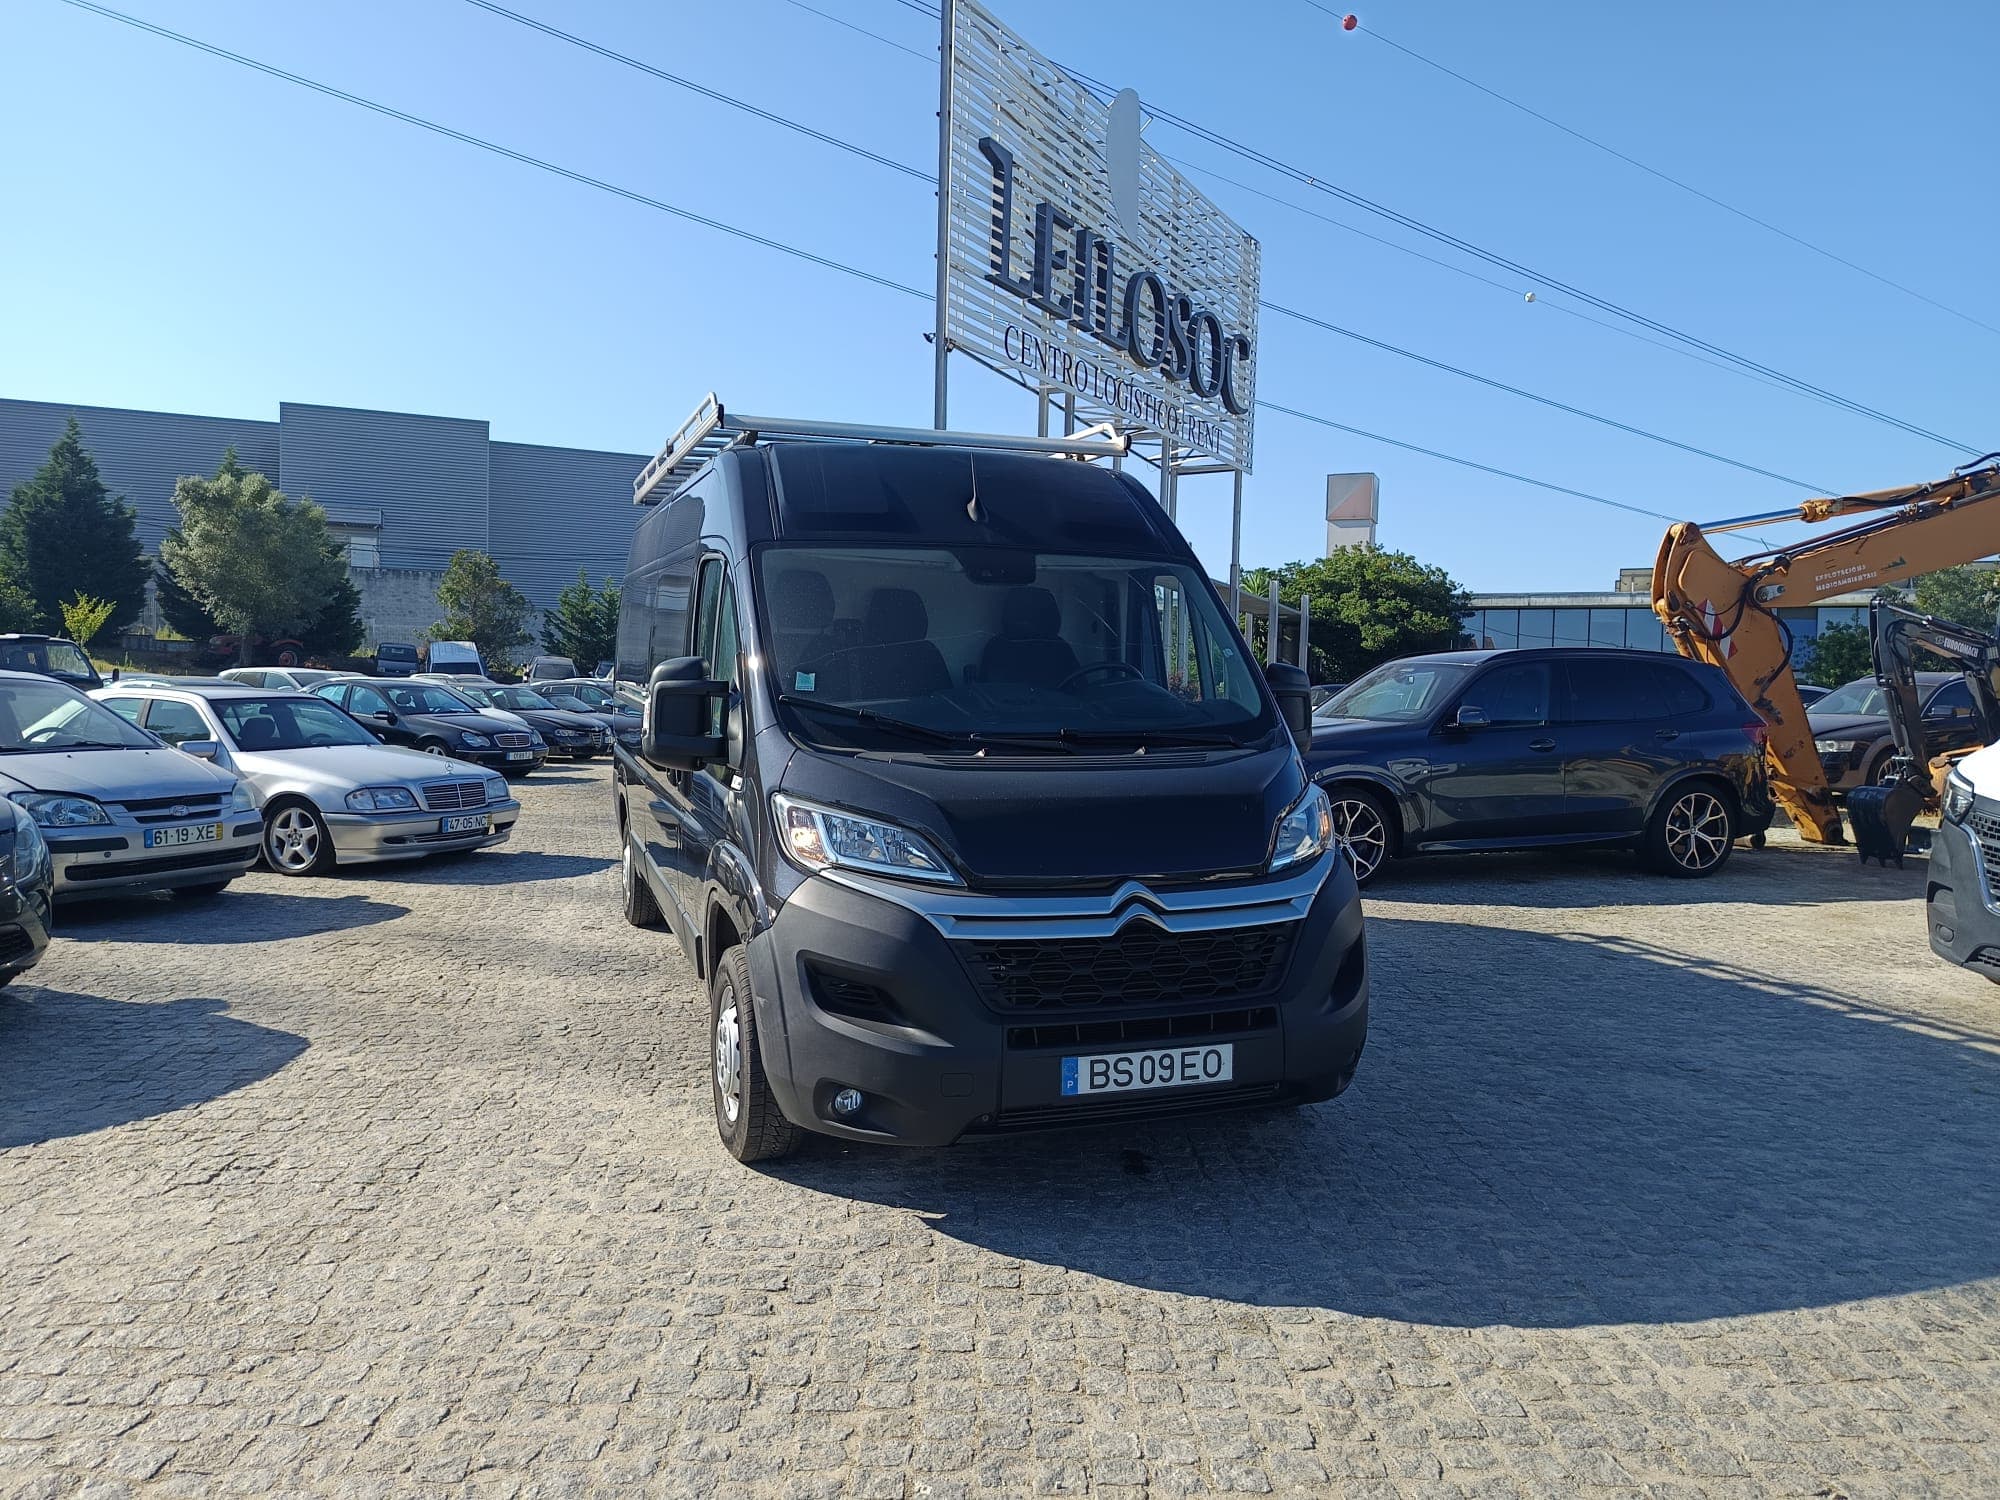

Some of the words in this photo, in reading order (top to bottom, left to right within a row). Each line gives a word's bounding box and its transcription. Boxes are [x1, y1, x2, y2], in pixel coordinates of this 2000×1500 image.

[979, 137, 1250, 415] LEILOSOC
[1004, 325, 1088, 393] CENTRO
[1188, 414, 1223, 454] RENT
[1067, 1080, 1074, 1089] P
